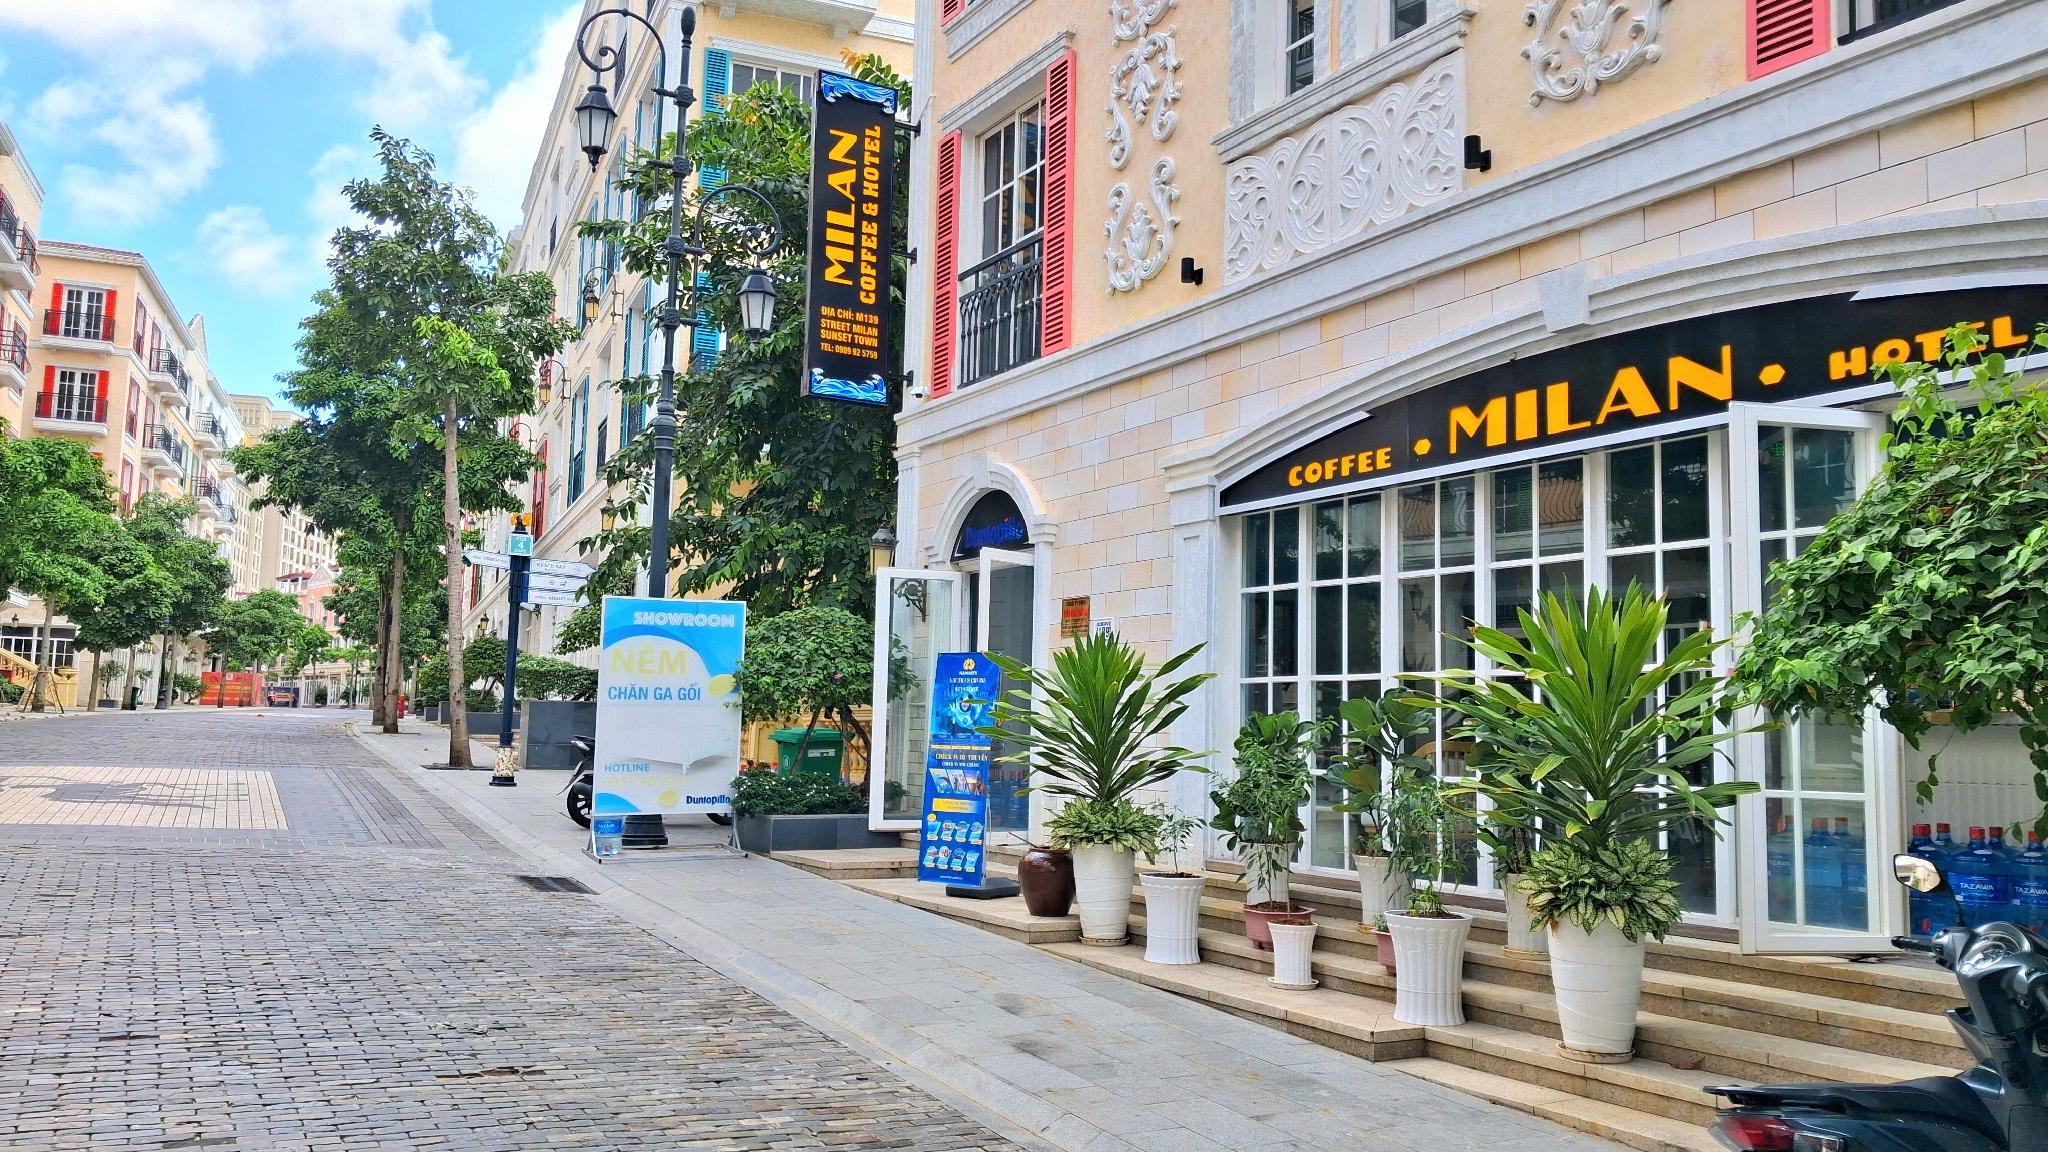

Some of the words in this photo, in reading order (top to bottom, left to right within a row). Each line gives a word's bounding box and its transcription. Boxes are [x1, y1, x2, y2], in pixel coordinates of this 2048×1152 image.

[863, 125, 881, 198] HOTEL
[824, 129, 858, 285] MILAN
[862, 202, 879, 216] &
[860, 220, 878, 305] COFFEE
[821, 318, 851, 332] STREET
[853, 324, 878, 337] MILAN
[856, 312, 879, 325] M139
[821, 329, 852, 343] SUNSET
[854, 334, 878, 348] TOWN
[821, 342, 835, 352] TEL:
[1288, 447, 1392, 487] COFFEE
[1450, 344, 1733, 454] MILAN
[633, 611, 735, 628] SHOWROOM
[611, 643, 688, 684] NỆM
[608, 682, 649, 701] CHĂN
[653, 687, 673, 701] GA
[678, 681, 701, 701] GỐI
[604, 763, 651, 773] HOTLINE
[1960, 882, 1995, 891] TAZAWA
